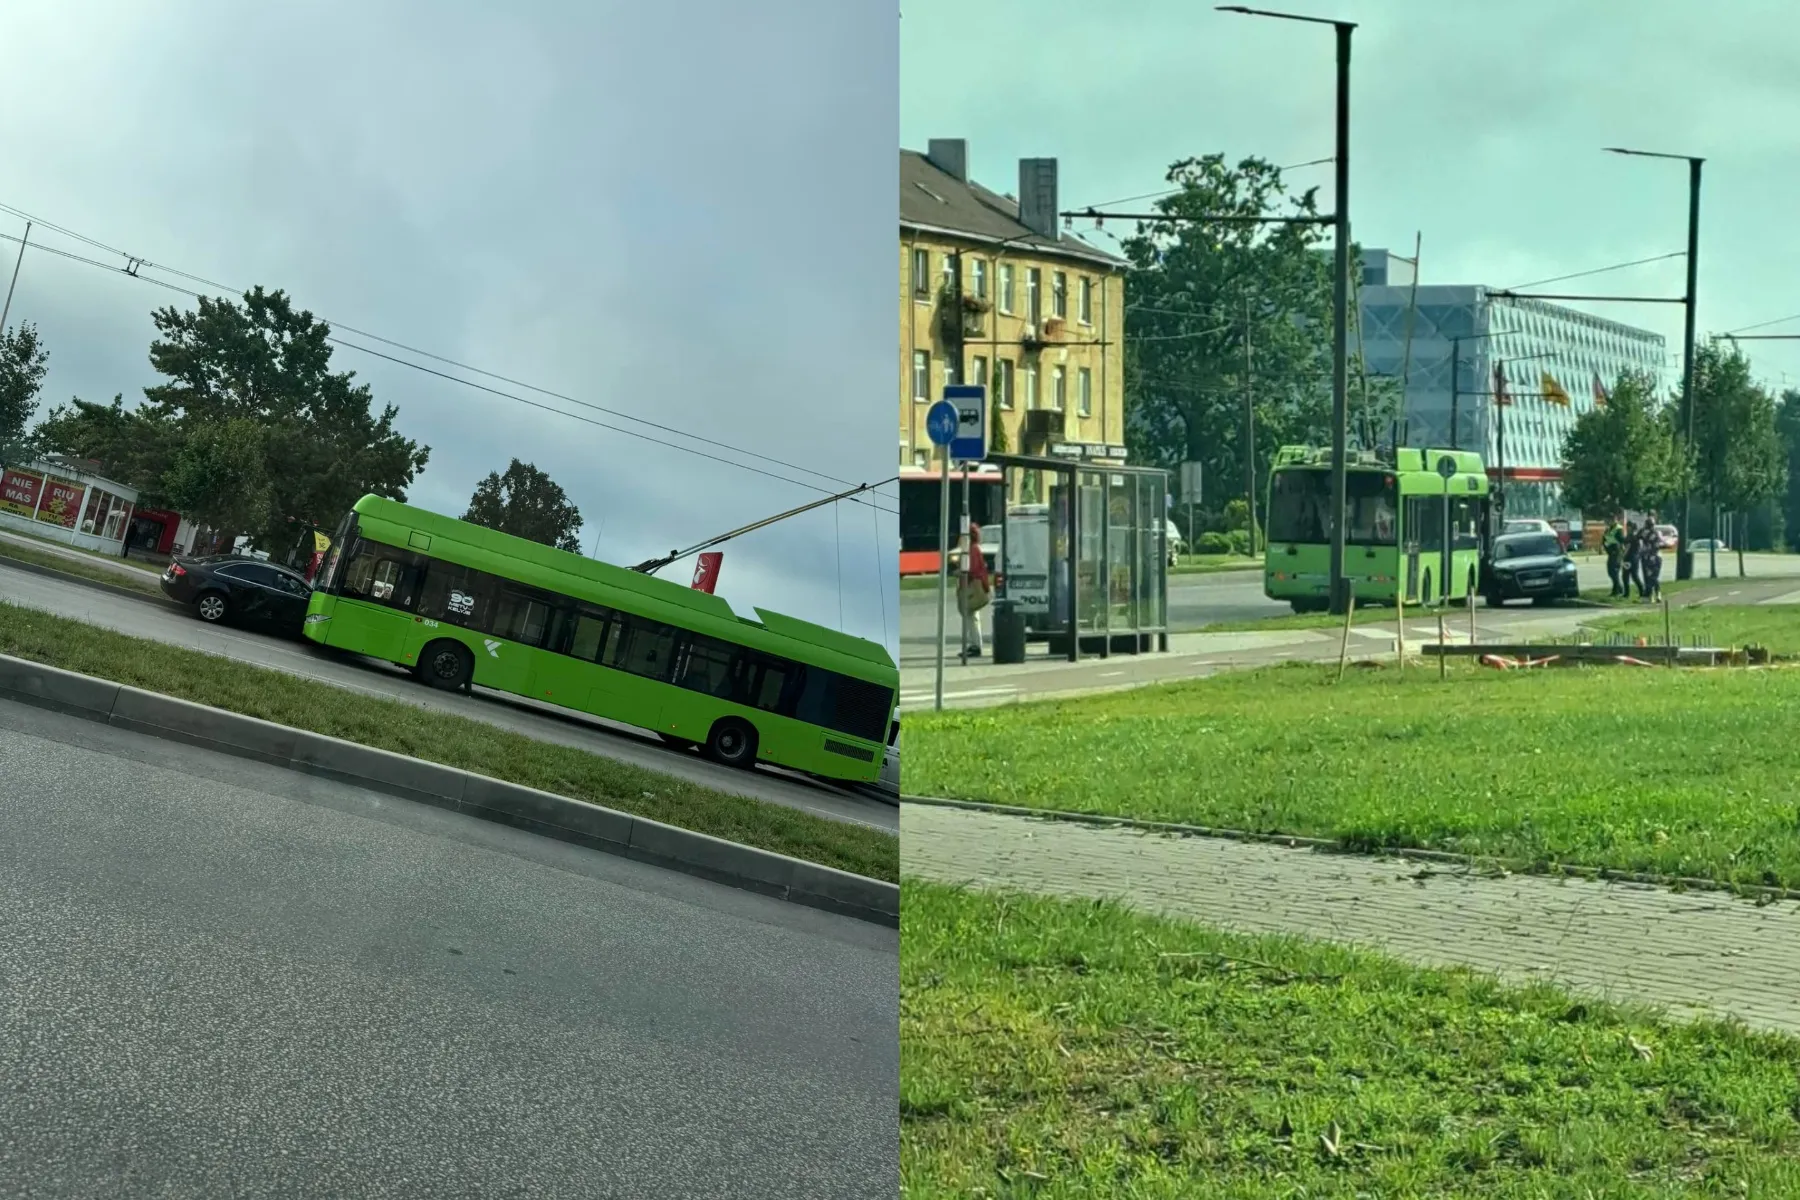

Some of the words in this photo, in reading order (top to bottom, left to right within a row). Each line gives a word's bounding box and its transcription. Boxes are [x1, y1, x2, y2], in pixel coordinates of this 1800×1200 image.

[11, 476, 33, 489] NIE
[5, 488, 32, 503] MAS
[451, 593, 475, 606] 90
[424, 619, 439, 629] 034
